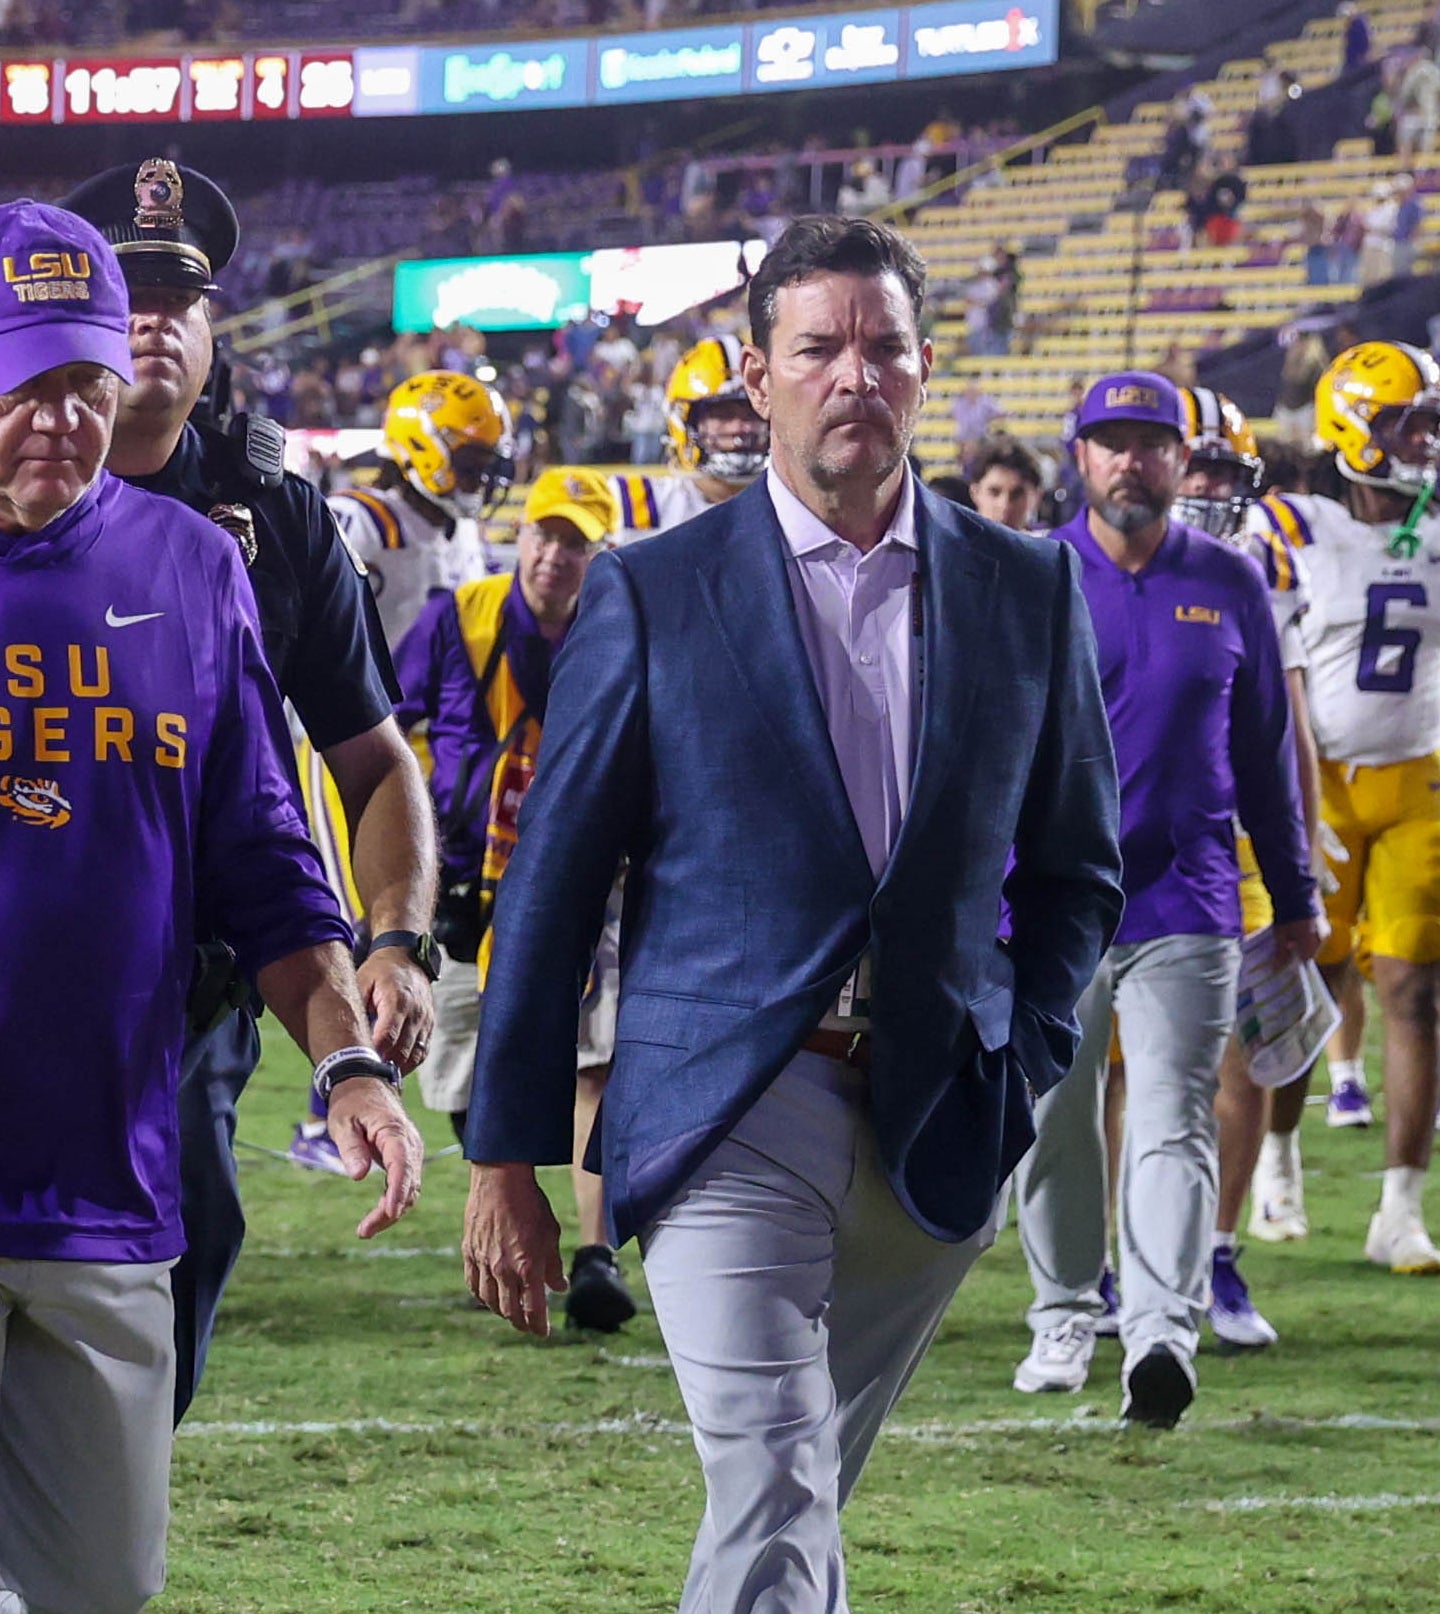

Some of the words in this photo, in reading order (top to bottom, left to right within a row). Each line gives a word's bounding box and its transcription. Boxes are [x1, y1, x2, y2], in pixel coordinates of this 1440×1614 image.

[2, 252, 91, 283] LSU
[13, 280, 90, 302] TIGERS
[1356, 582, 1428, 693] 6
